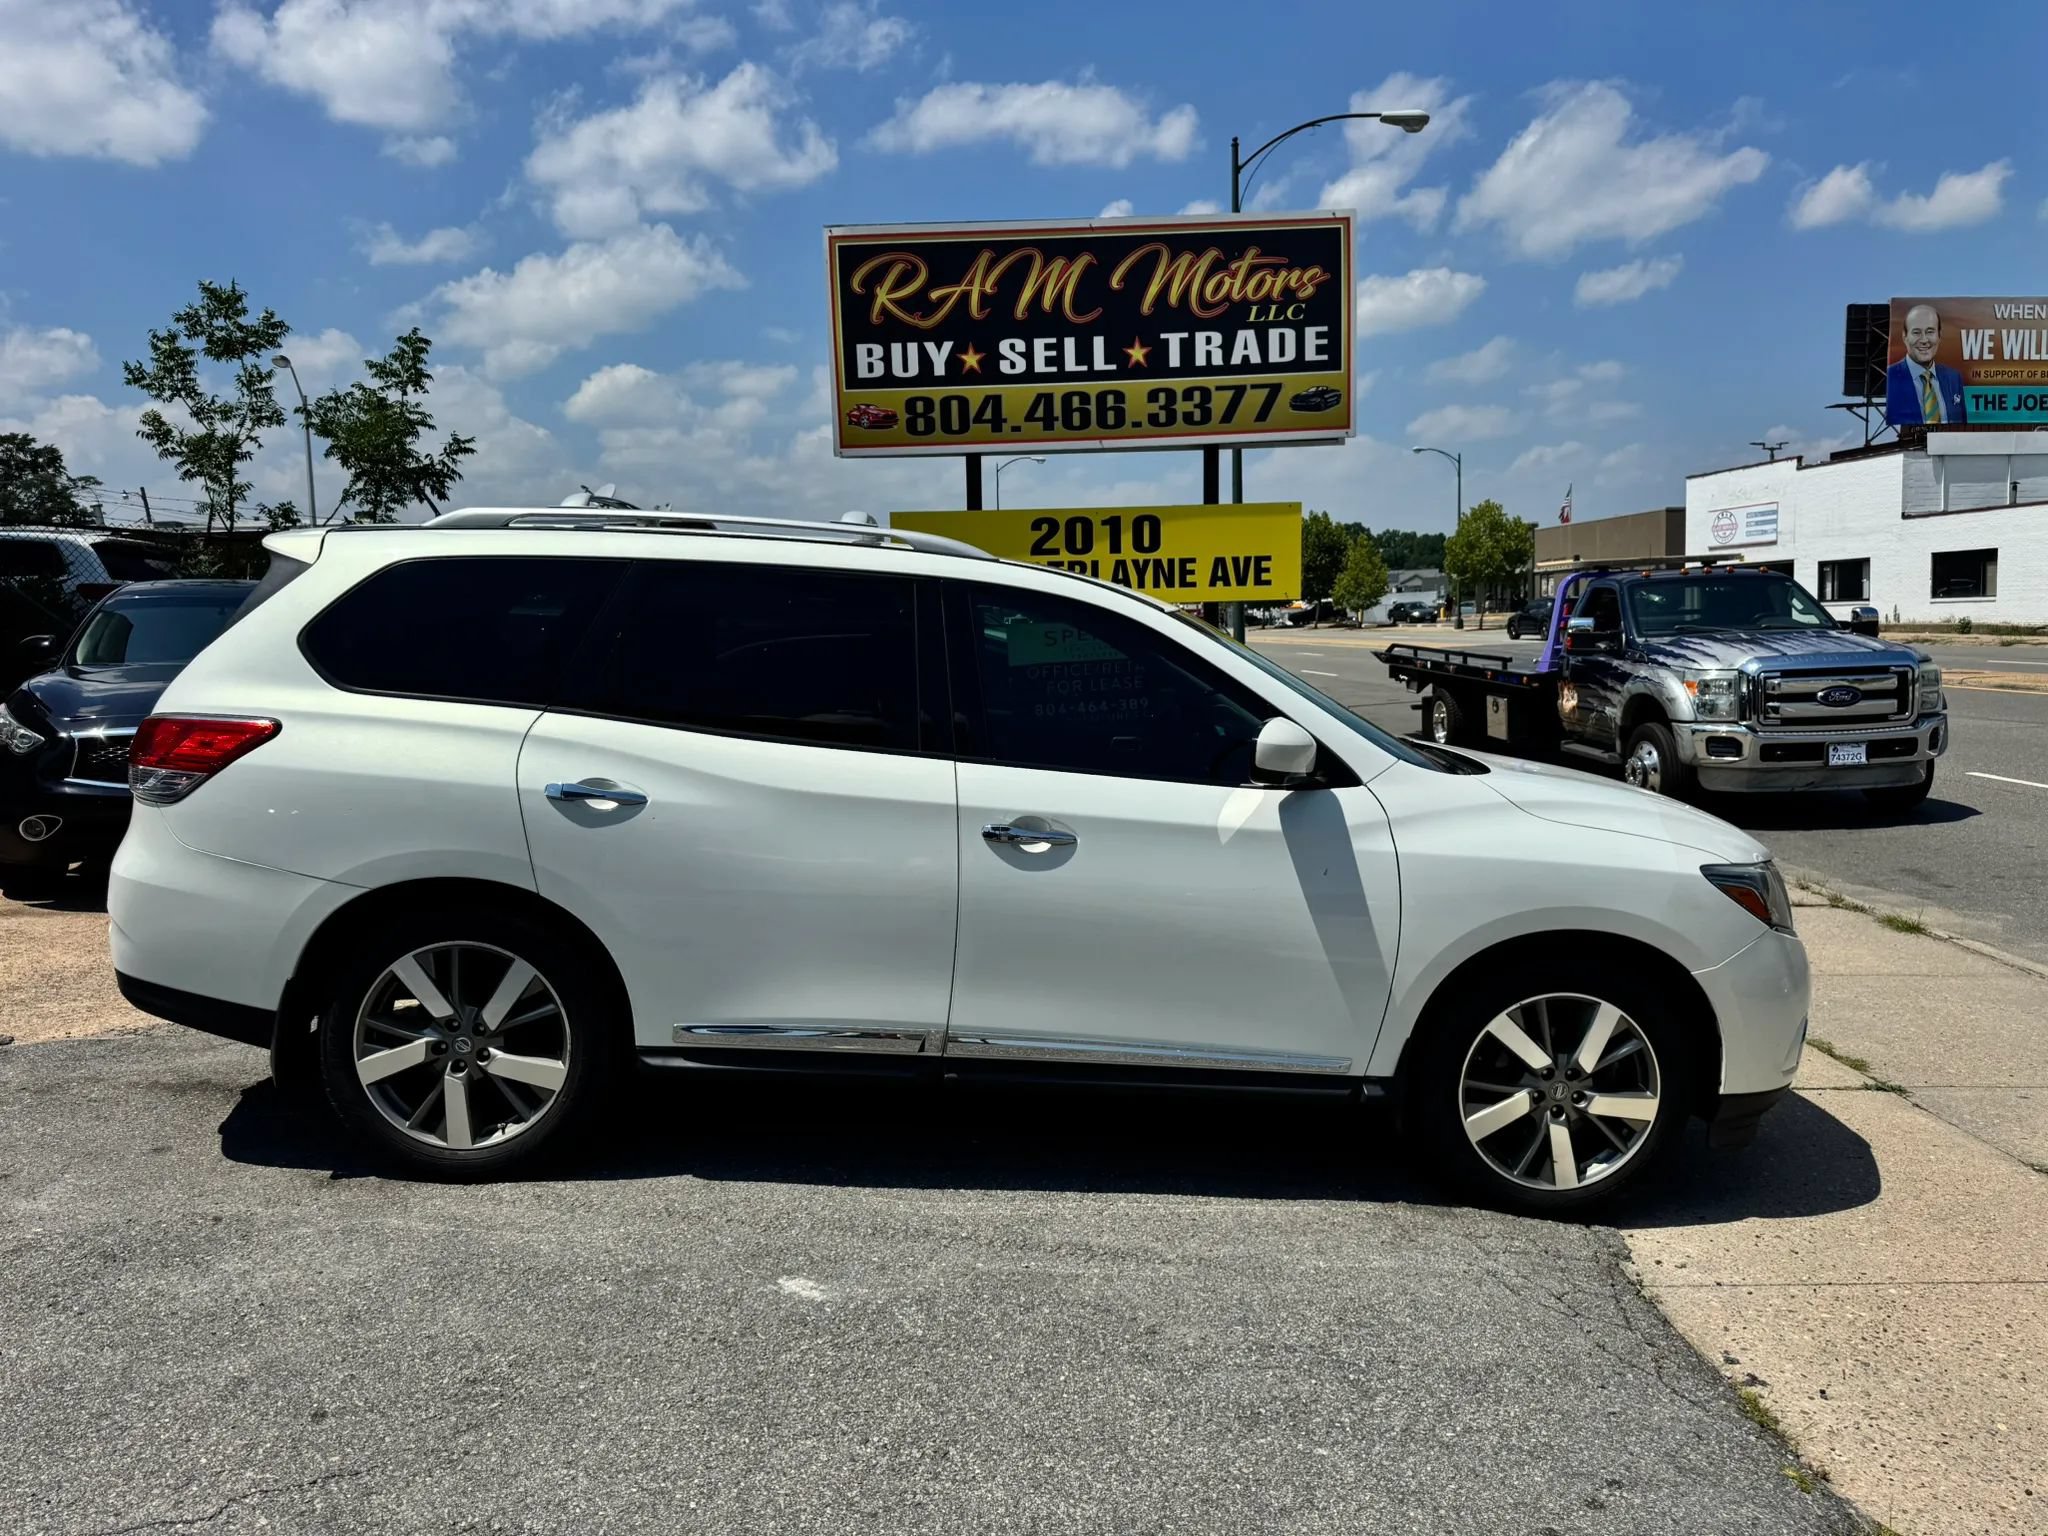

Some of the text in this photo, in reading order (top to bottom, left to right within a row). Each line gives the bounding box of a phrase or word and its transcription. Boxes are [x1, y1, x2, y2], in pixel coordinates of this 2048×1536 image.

[1109, 242, 1330, 318] Motors
[1246, 303, 1306, 322] LLC
[1994, 304, 2046, 319] WHEN
[856, 325, 1329, 379] BUY SELL TRADE
[1961, 329, 2048, 360] WE WILL
[1972, 370, 1981, 378] IN
[1983, 370, 2025, 379] SUPPORT
[2027, 370, 2039, 378] OF
[904, 382, 1283, 436] 804.466.3377
[1972, 394, 2048, 411] THE JOE
[1029, 514, 1162, 556] 2010
[1208, 555, 1273, 588] AVE
[1046, 675, 1144, 695] FOR LEASE
[1829, 692, 1853, 702] Ford
